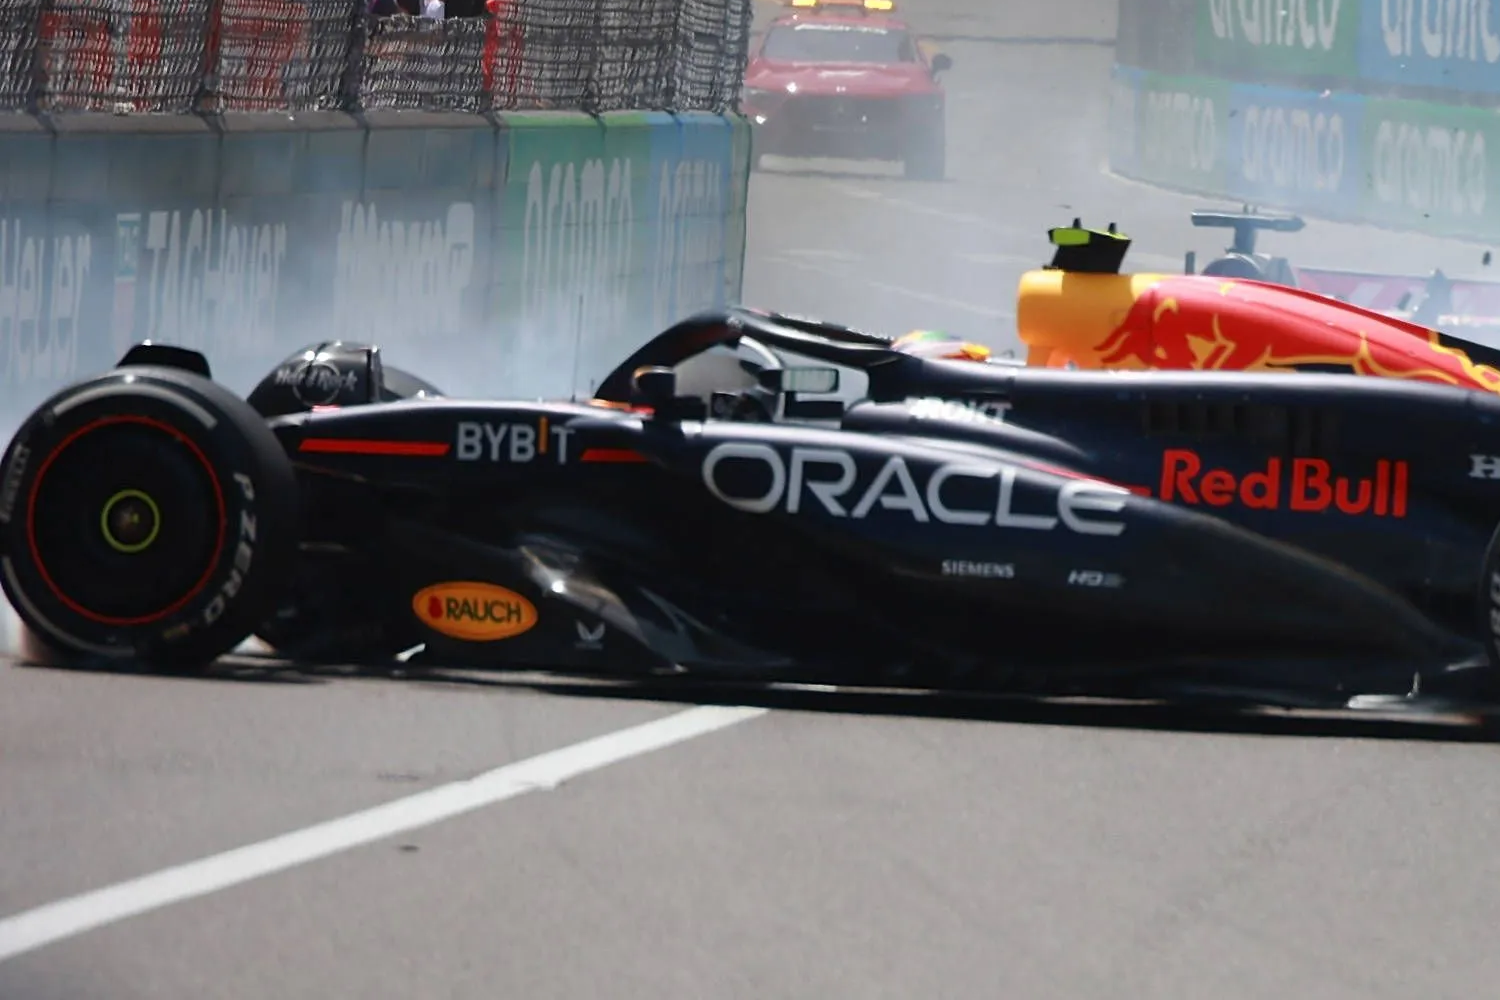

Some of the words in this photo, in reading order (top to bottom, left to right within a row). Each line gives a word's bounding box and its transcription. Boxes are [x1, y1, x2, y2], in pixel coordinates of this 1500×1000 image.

[456, 415, 576, 465] BYBIT
[702, 442, 1131, 536] ORACLE
[1160, 449, 1281, 509] Red
[1292, 457, 1408, 516] Bull
[941, 559, 1015, 579] SIEMENS
[446, 597, 522, 623] RAUCH
